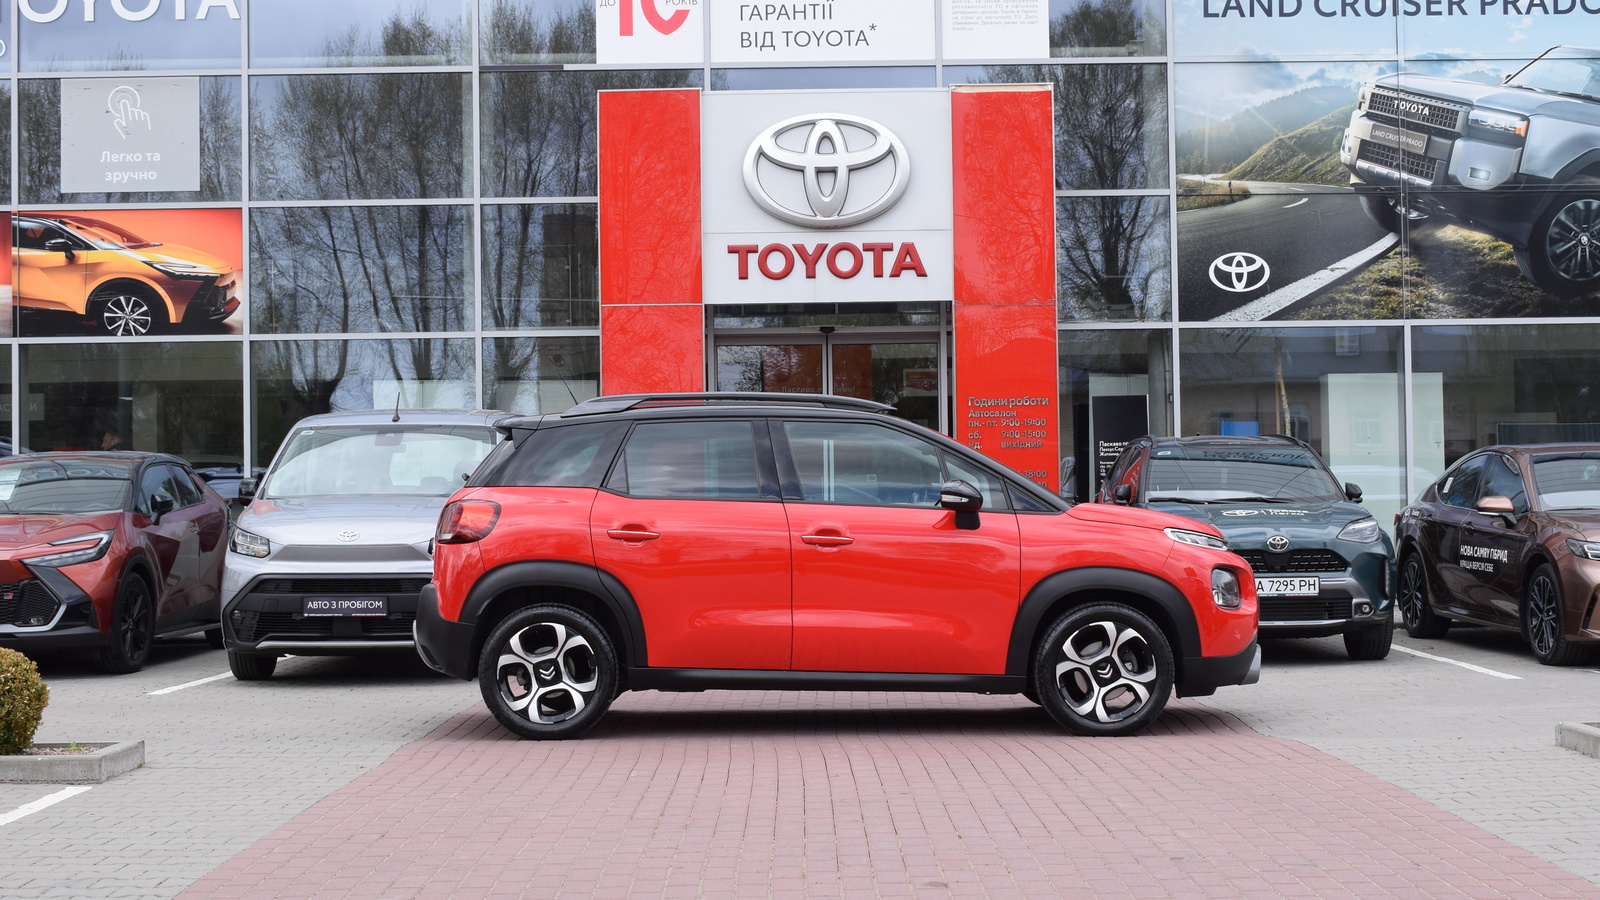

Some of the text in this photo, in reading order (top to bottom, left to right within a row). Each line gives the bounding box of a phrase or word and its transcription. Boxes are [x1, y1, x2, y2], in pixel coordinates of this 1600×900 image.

[740, 0, 835, 21] ГАРАНТІЇ
[1203, 0, 1302, 18] LAND
[1313, 0, 1469, 18] CRUISER
[740, 31, 776, 51] ВІД
[1393, 100, 1430, 116] TOYOTA
[1372, 129, 1384, 138] LAND
[101, 151, 161, 163] Легко та
[105, 170, 157, 184] зручно
[727, 242, 928, 281] TOYOTA
[968, 396, 1049, 407] Години роботи
[968, 409, 1016, 418] Автосалон
[968, 431, 982, 439] сб.
[1460, 544, 1473, 556] НОВА
[1268, 580, 1295, 592] 7295
[1299, 579, 1316, 591] PH
[307, 600, 383, 609] АВТО З ПРОБІГОМ
